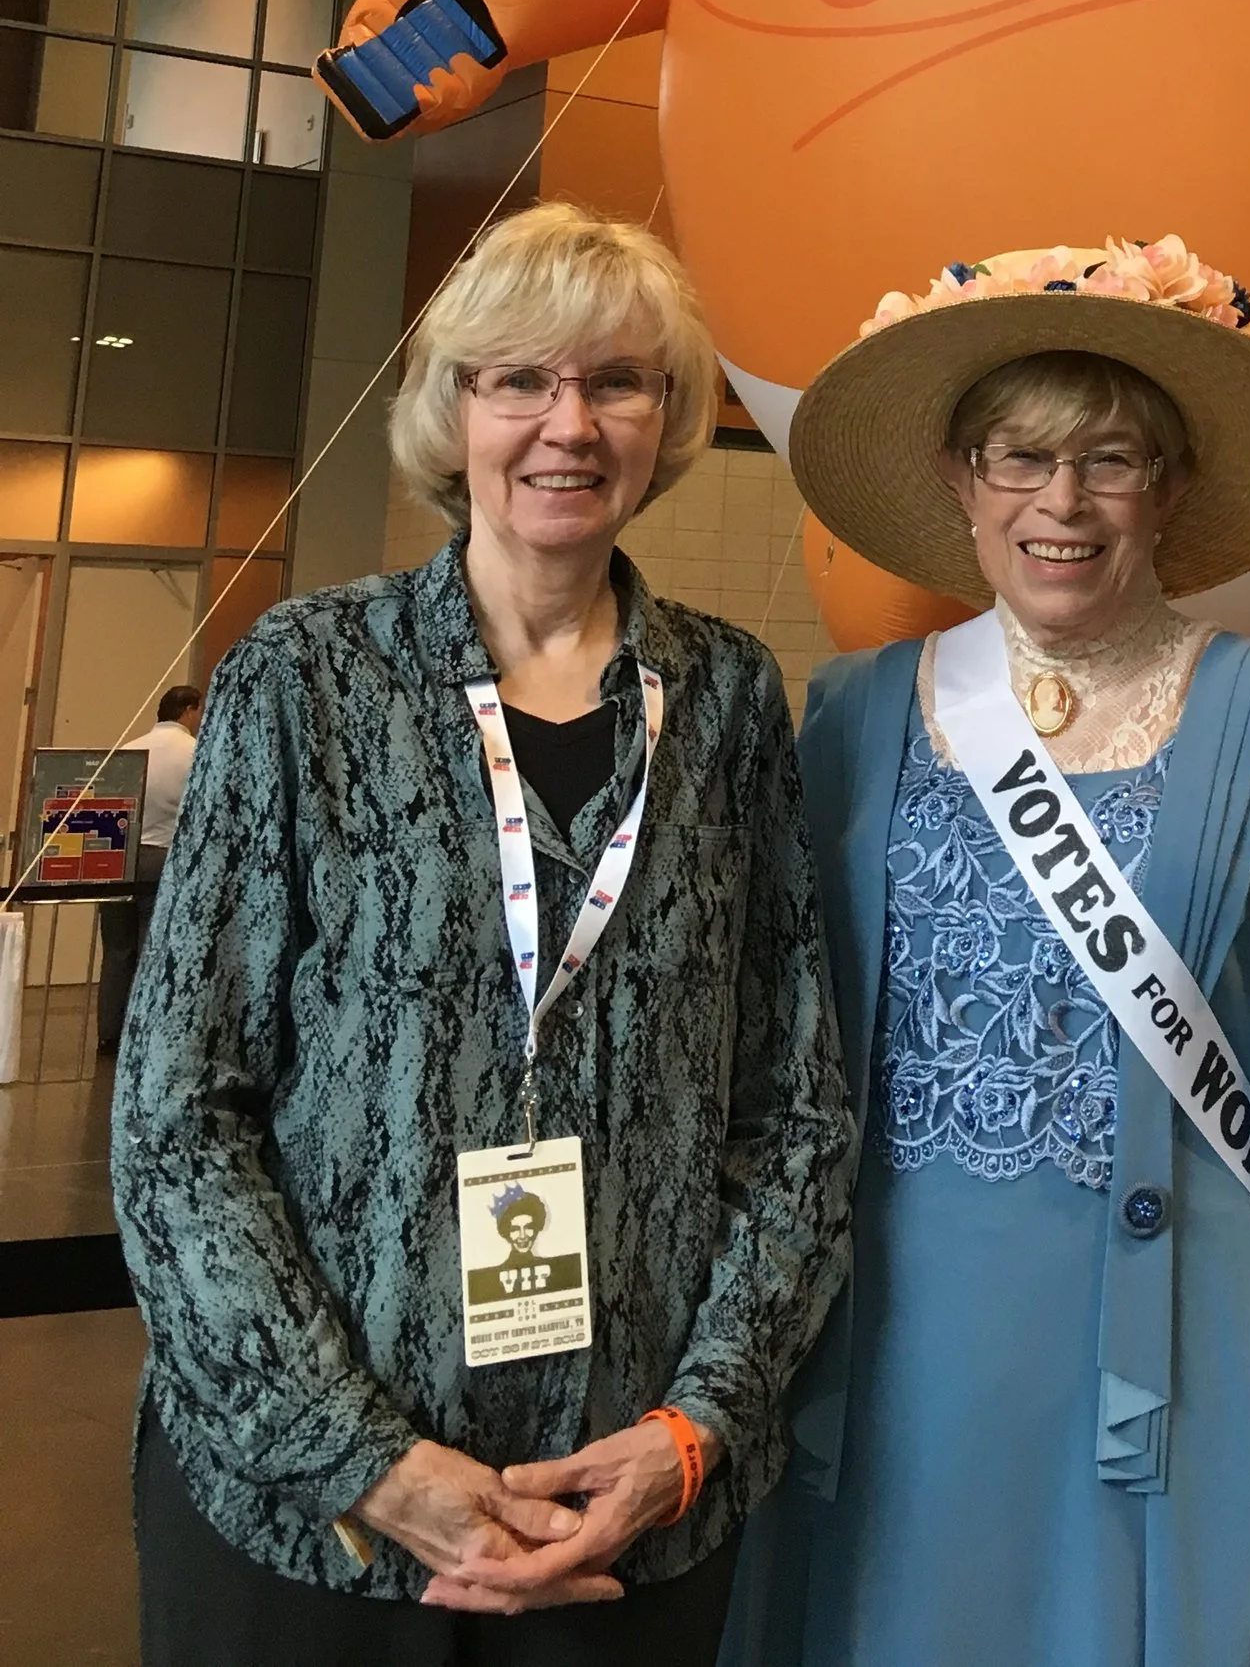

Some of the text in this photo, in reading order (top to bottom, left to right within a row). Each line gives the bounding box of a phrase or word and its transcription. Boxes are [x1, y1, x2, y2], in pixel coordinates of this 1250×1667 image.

[990, 747, 1148, 974] VOTES
[1131, 973, 1193, 1057] FOR
[499, 1264, 551, 1294] VIP
